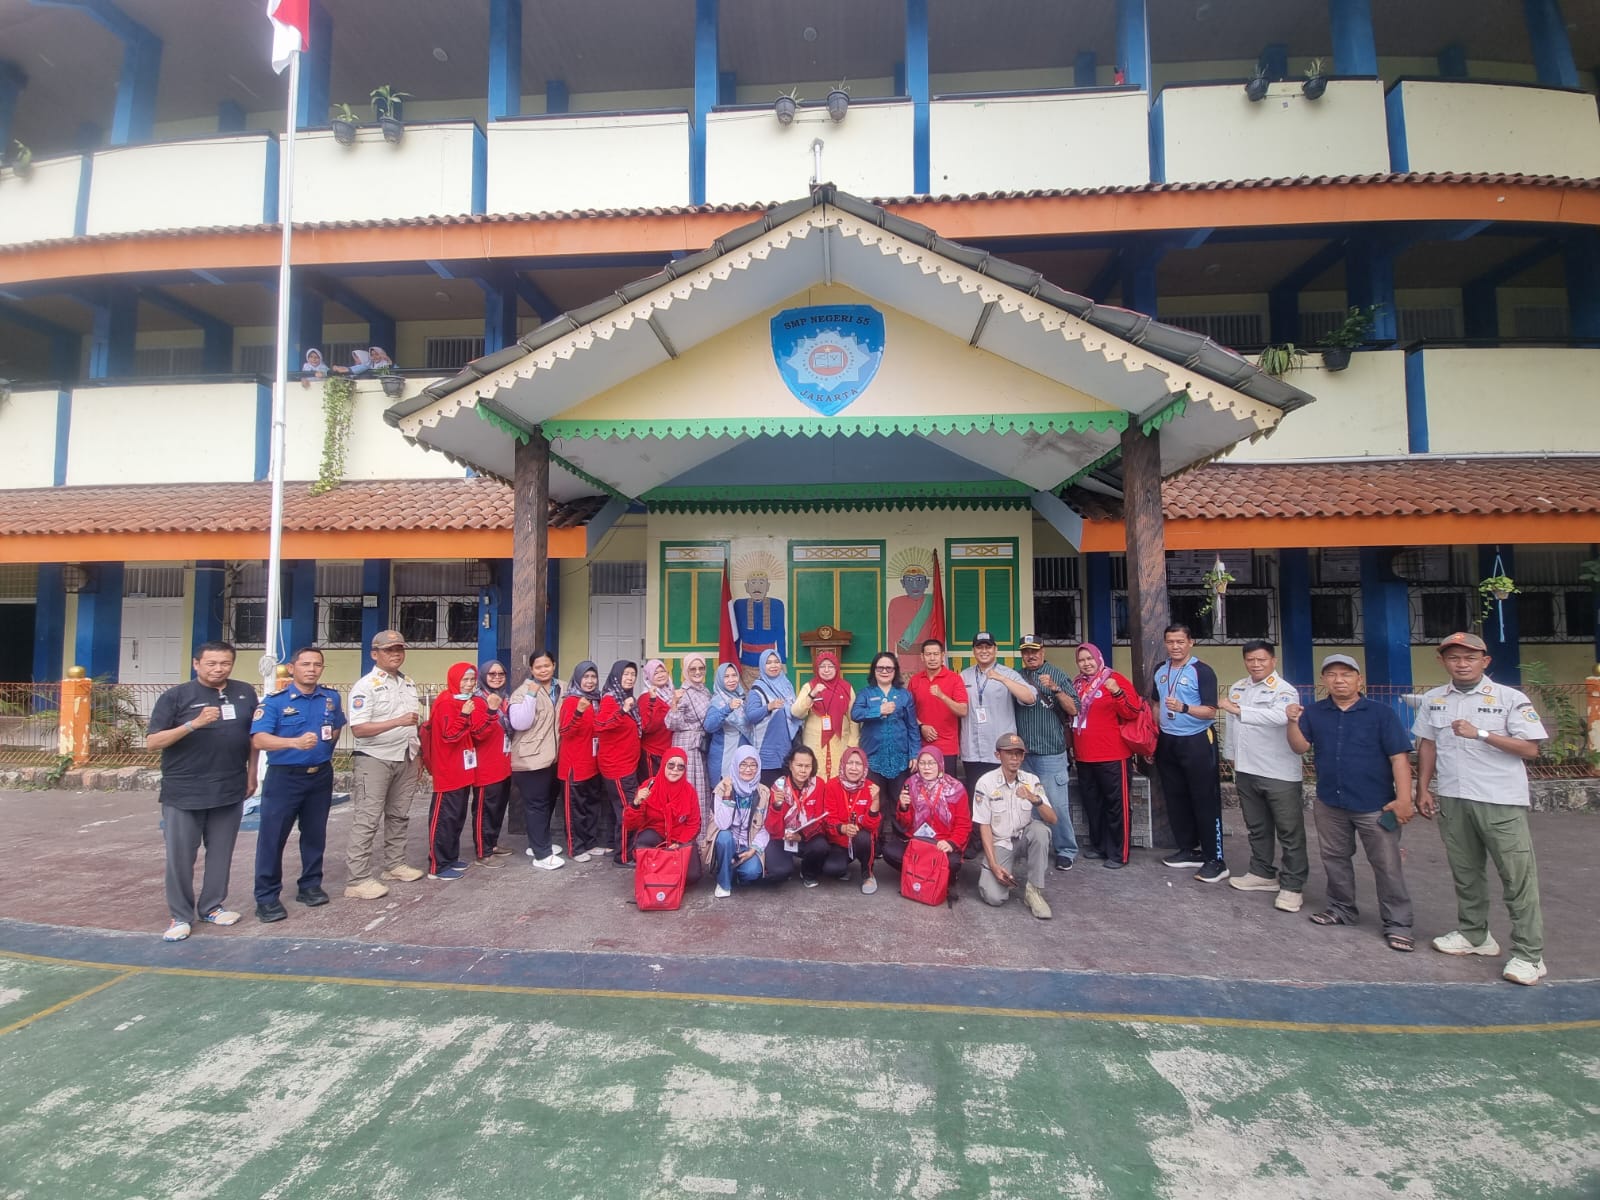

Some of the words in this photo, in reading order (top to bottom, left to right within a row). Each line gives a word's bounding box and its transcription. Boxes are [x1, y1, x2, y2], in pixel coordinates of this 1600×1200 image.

[784, 318, 807, 330] SMP
[810, 314, 853, 324] NEGERI
[856, 316, 871, 326] 55
[800, 388, 858, 402] JAKARTA
